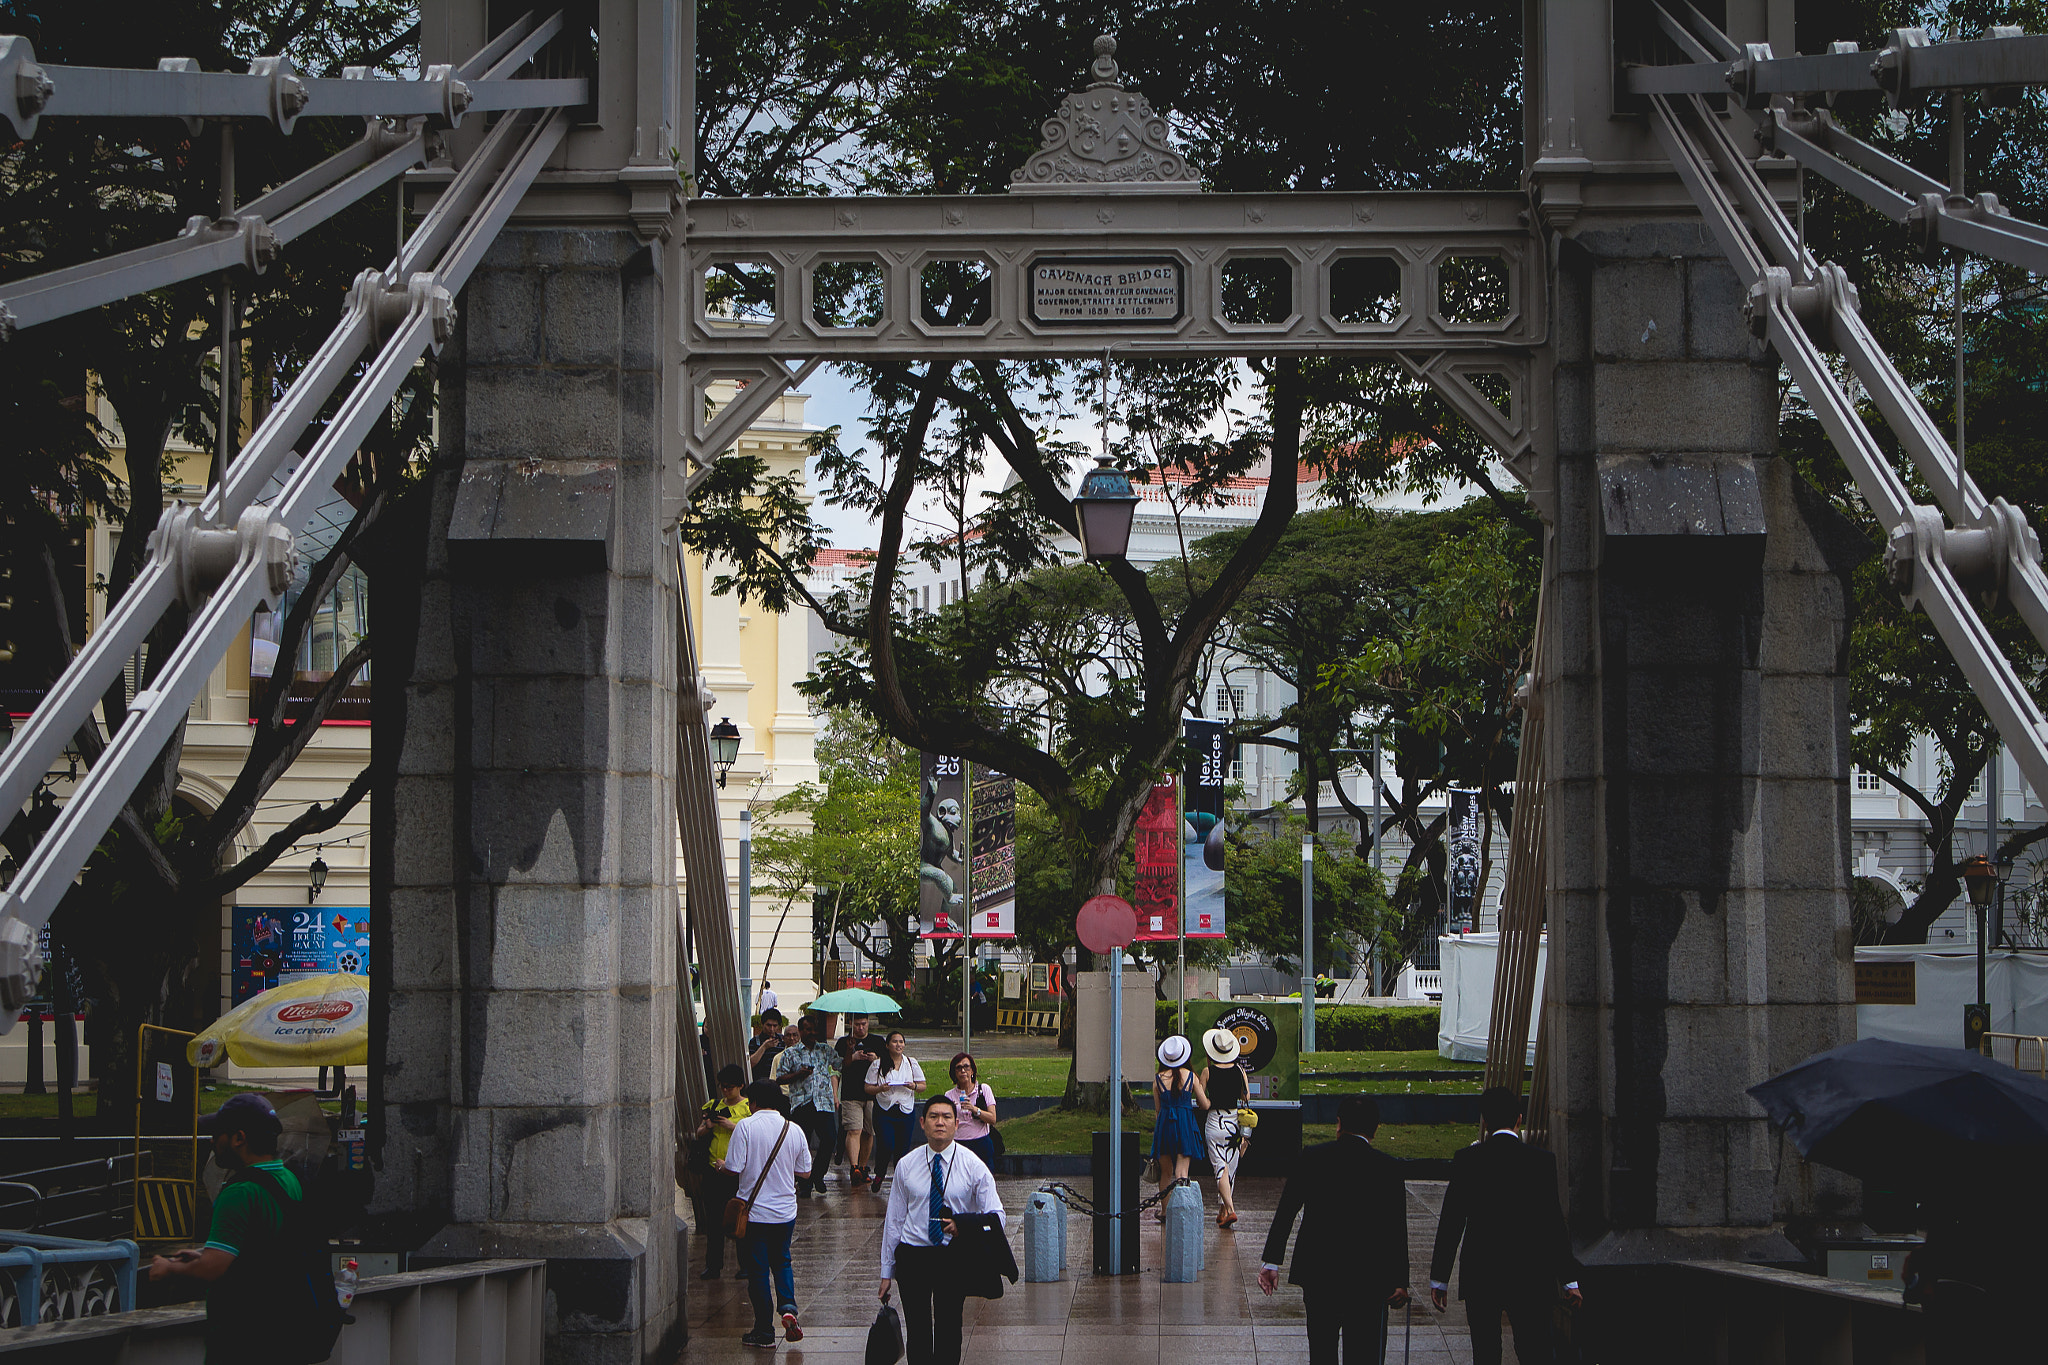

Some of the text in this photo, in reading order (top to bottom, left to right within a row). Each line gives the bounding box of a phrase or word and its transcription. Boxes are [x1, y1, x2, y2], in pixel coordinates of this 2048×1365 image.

[1039, 268, 1172, 286] CAVENAGH BRIDGE
[1038, 288, 1065, 296] MAJOR
[1068, 288, 1103, 296] GENERAL
[1104, 287, 1134, 295] ORFEUR
[1118, 297, 1174, 305] SETTLEMENTS
[1115, 307, 1126, 315] TO
[1210, 733, 1223, 787] Spaces
[1468, 794, 1476, 838] Galleries
[1461, 815, 1469, 838] New
[292, 911, 326, 934] 24
[293, 933, 326, 941] HOURS
[283, 1003, 350, 1019] Magnolia
[1236, 1007, 1257, 1020] Night
[274, 1026, 336, 1035] ice cream
